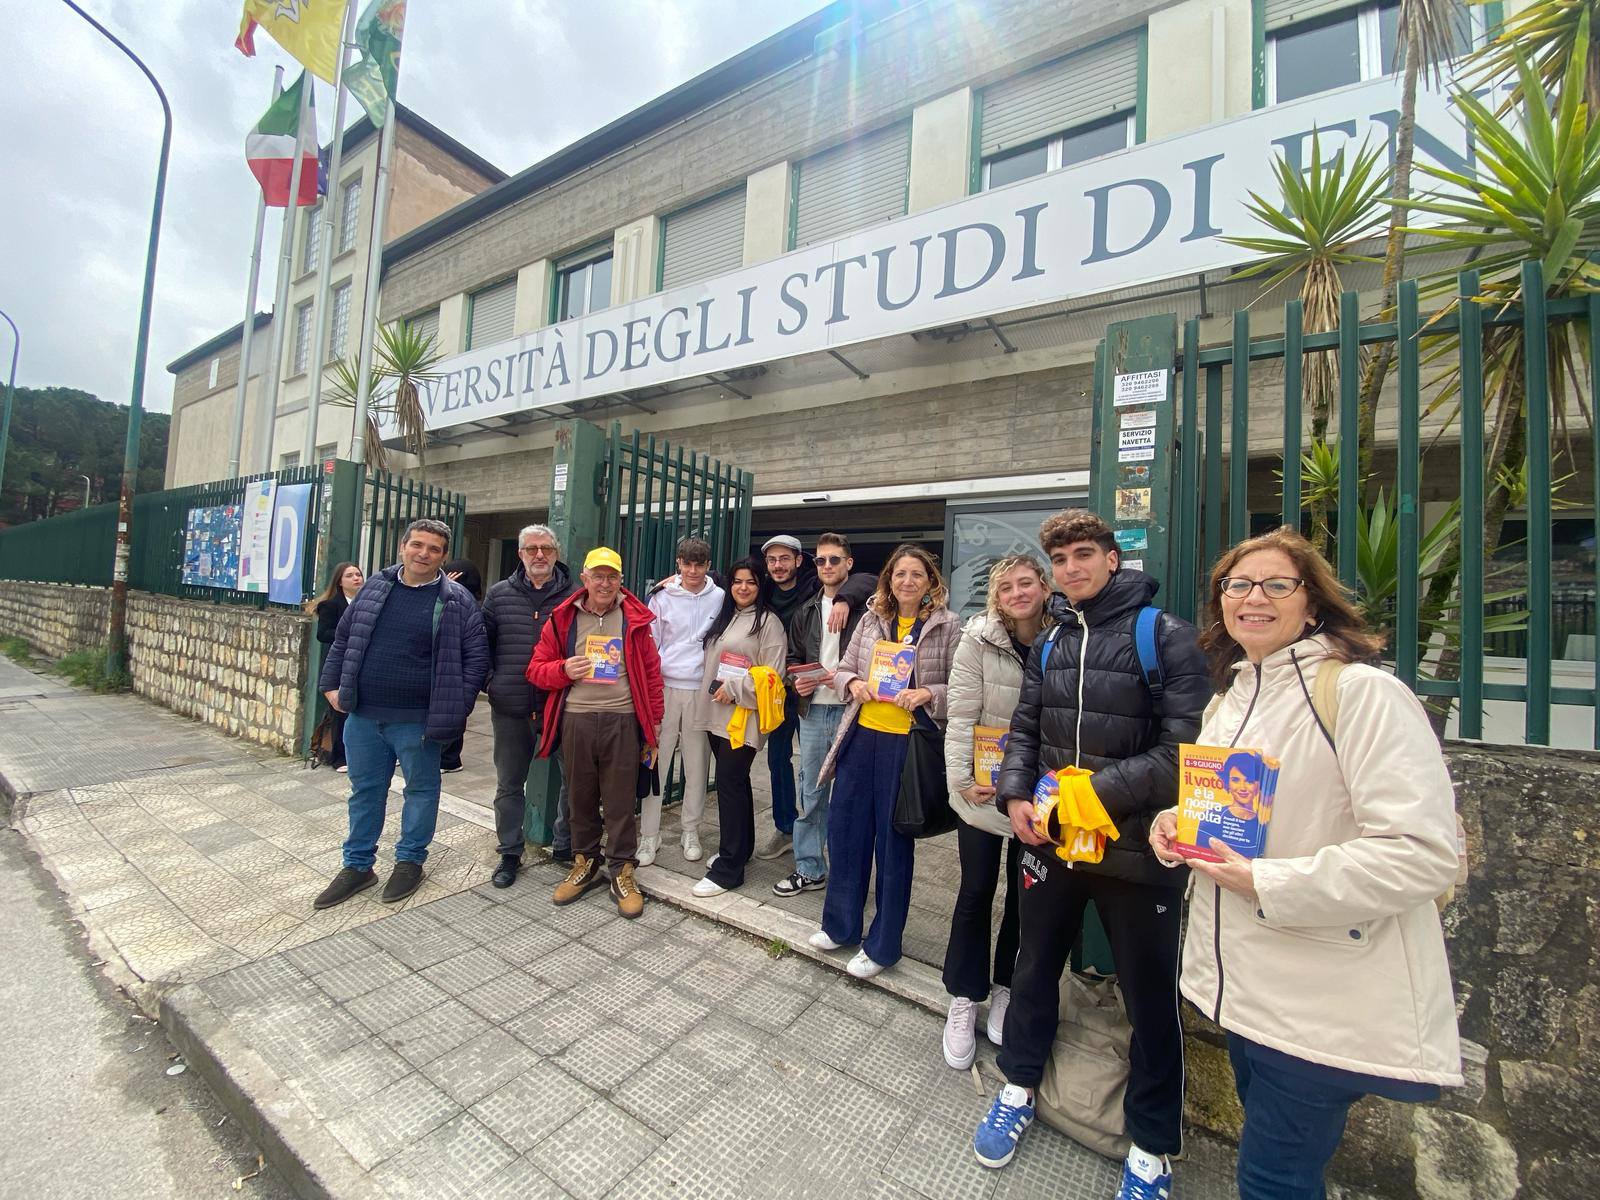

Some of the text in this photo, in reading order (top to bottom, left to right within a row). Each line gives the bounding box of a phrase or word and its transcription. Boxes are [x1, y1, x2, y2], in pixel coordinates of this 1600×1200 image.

[374, 328, 571, 428] UVERSITÀ
[583, 286, 758, 381] DEGLI
[778, 202, 1048, 336] STUDI
[1081, 153, 1225, 267] DI
[1121, 371, 1161, 382] AFFITTASI
[1122, 429, 1152, 438] SERVIZIO
[1122, 437, 1151, 446] NAVETTA
[273, 505, 299, 580] D
[1198, 760, 1222, 769] GIUGNO
[1184, 771, 1224, 789] il voto
[1203, 787, 1215, 800] la
[1185, 797, 1222, 812] nostra
[1183, 808, 1221, 824] rivolta
